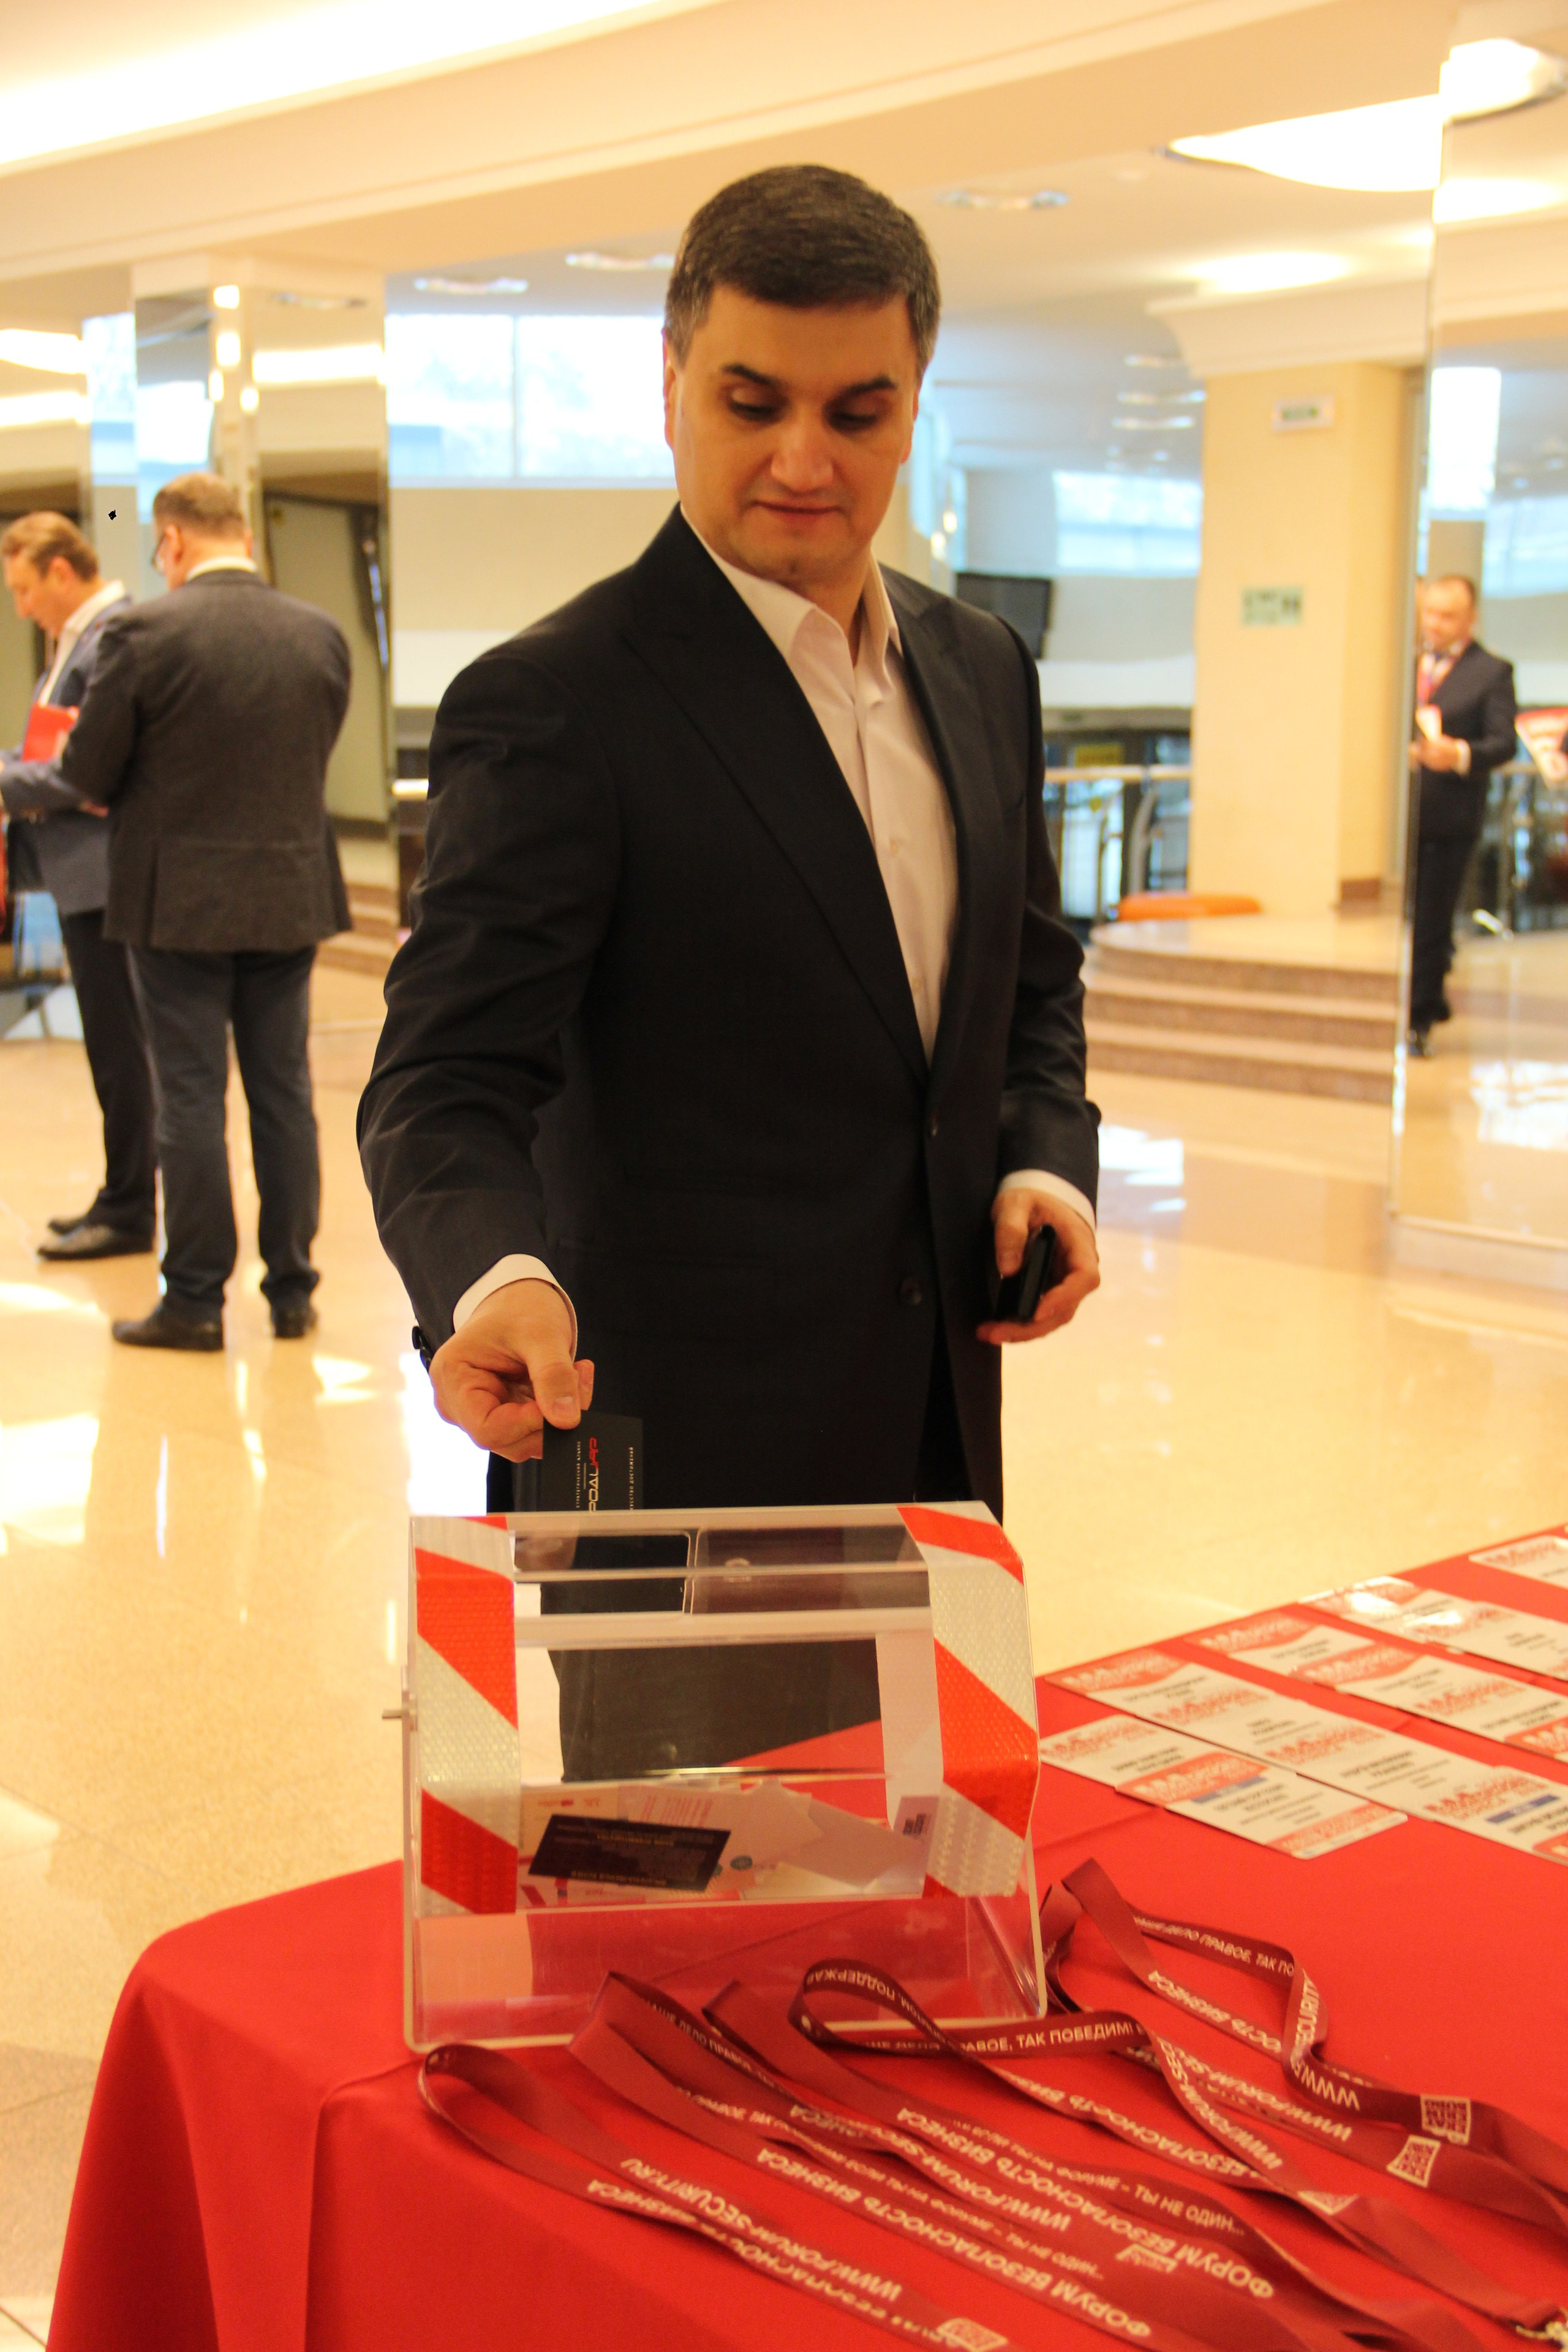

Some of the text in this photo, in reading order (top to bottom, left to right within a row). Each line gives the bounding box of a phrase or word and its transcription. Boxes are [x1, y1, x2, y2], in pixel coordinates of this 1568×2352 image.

[1256, 1953, 1277, 1971] ТАК
[1016, 2032, 1046, 2049] ТАК
[1050, 2021, 1133, 2045] ПОБЕДИМ!
[896, 2107, 996, 2165] БИЗНЕСА
[996, 2157, 1178, 2255] БЕЗОПАСНОСТЬ
[1134, 2183, 1159, 2206] ТЫ
[1159, 2195, 1185, 2217] НЕ
[1185, 2205, 1245, 2236] ОДИН...
[757, 2147, 1152, 2337] ФОРУМ БЕЗОПАСНОСТЬ БИЗНЕСА
[1028, 2243, 1054, 2261] НЕ
[1174, 2243, 1275, 2298] ФОРУМ
